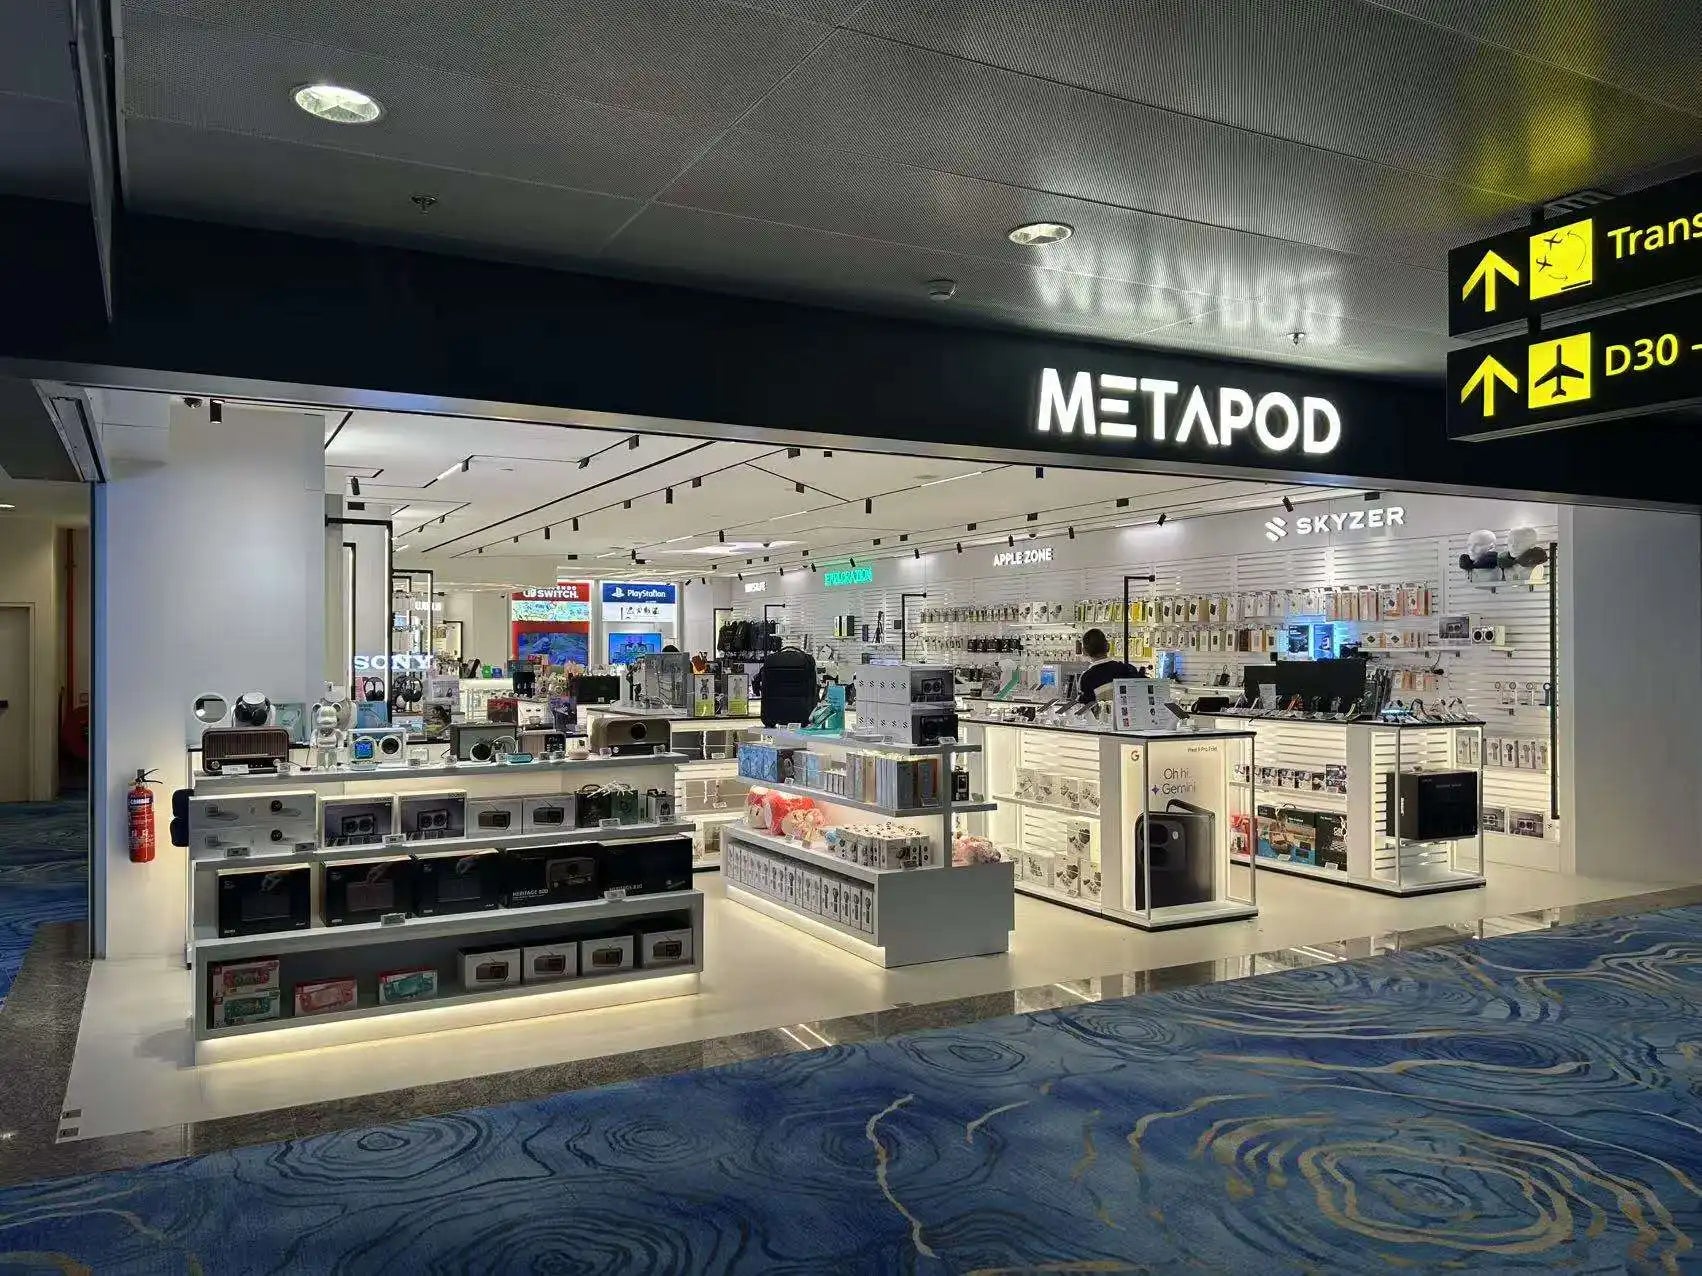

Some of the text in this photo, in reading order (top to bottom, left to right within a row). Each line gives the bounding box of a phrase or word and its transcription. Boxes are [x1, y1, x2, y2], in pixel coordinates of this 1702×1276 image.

[1605, 333, 1679, 376] D30
[1038, 367, 1342, 454] METAPOD
[1296, 506, 1405, 536] SKYZER
[993, 547, 1053, 567] APPLE ZONE
[627, 589, 666, 599] PlayStation
[354, 655, 434, 670] SONY
[1164, 768, 1179, 780] Oh
[1162, 781, 1196, 795] Gemini
